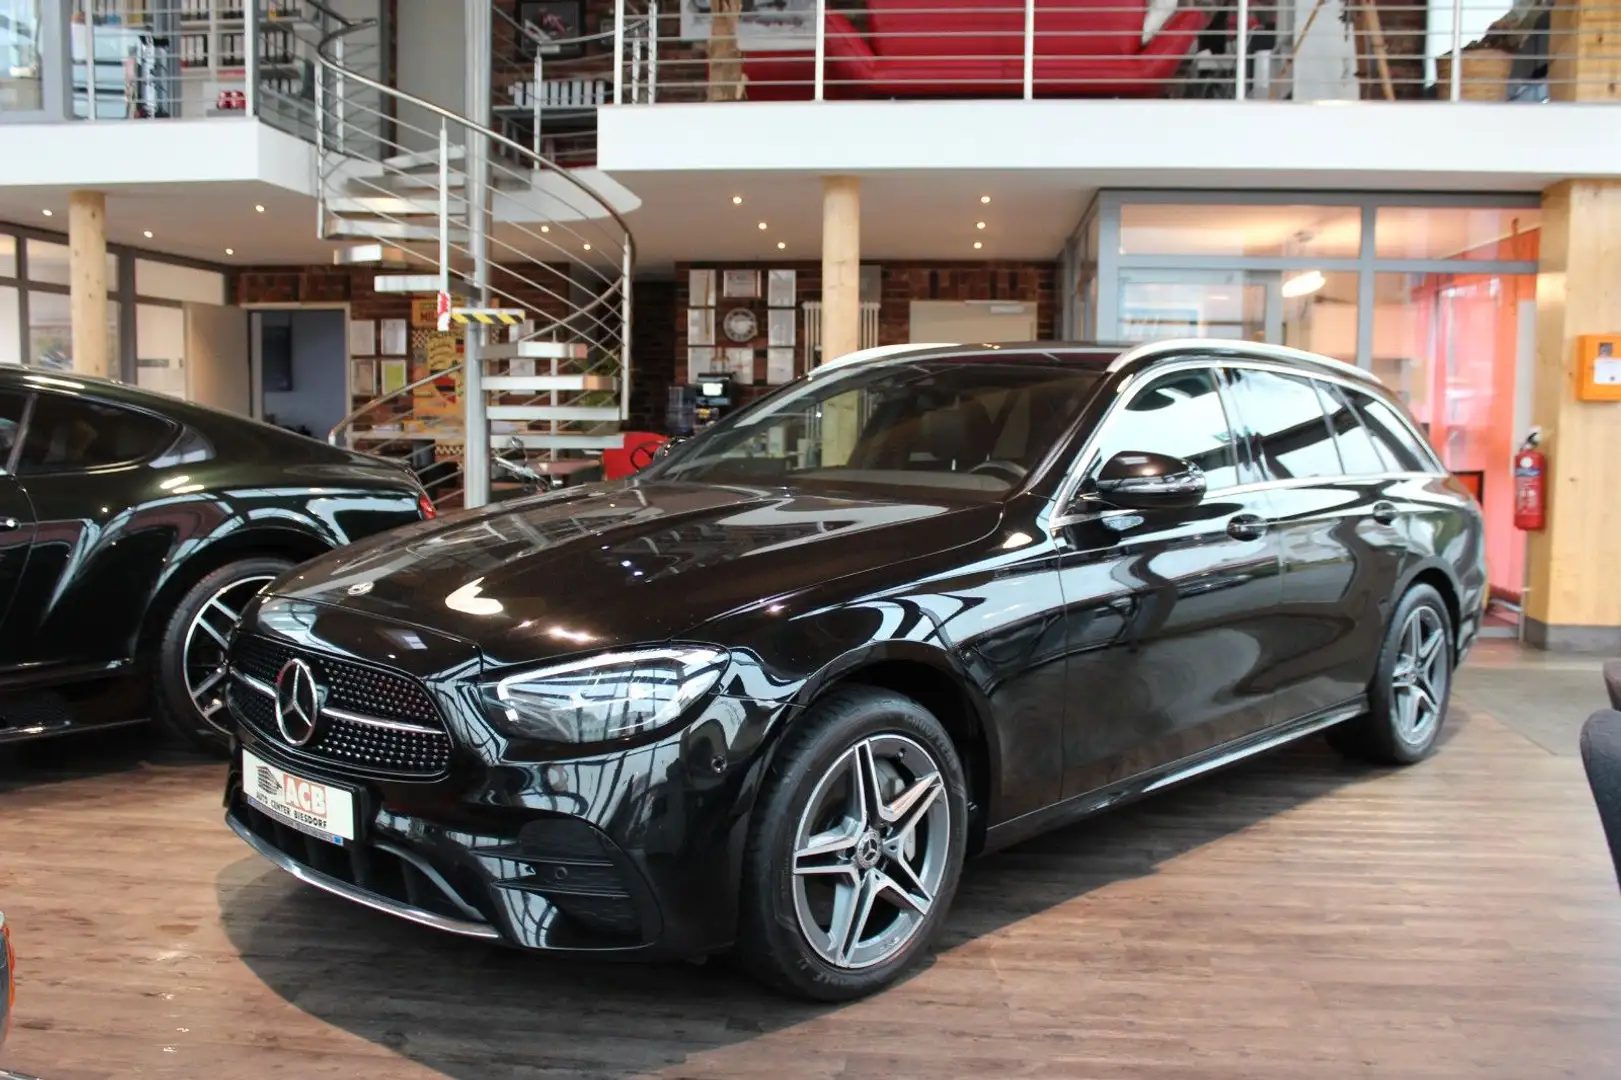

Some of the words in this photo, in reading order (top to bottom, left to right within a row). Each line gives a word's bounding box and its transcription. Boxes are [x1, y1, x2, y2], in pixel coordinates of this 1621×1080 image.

[271, 799, 290, 815] CENTER
[294, 810, 327, 828] BIESDORF
[284, 774, 326, 817] ACB
